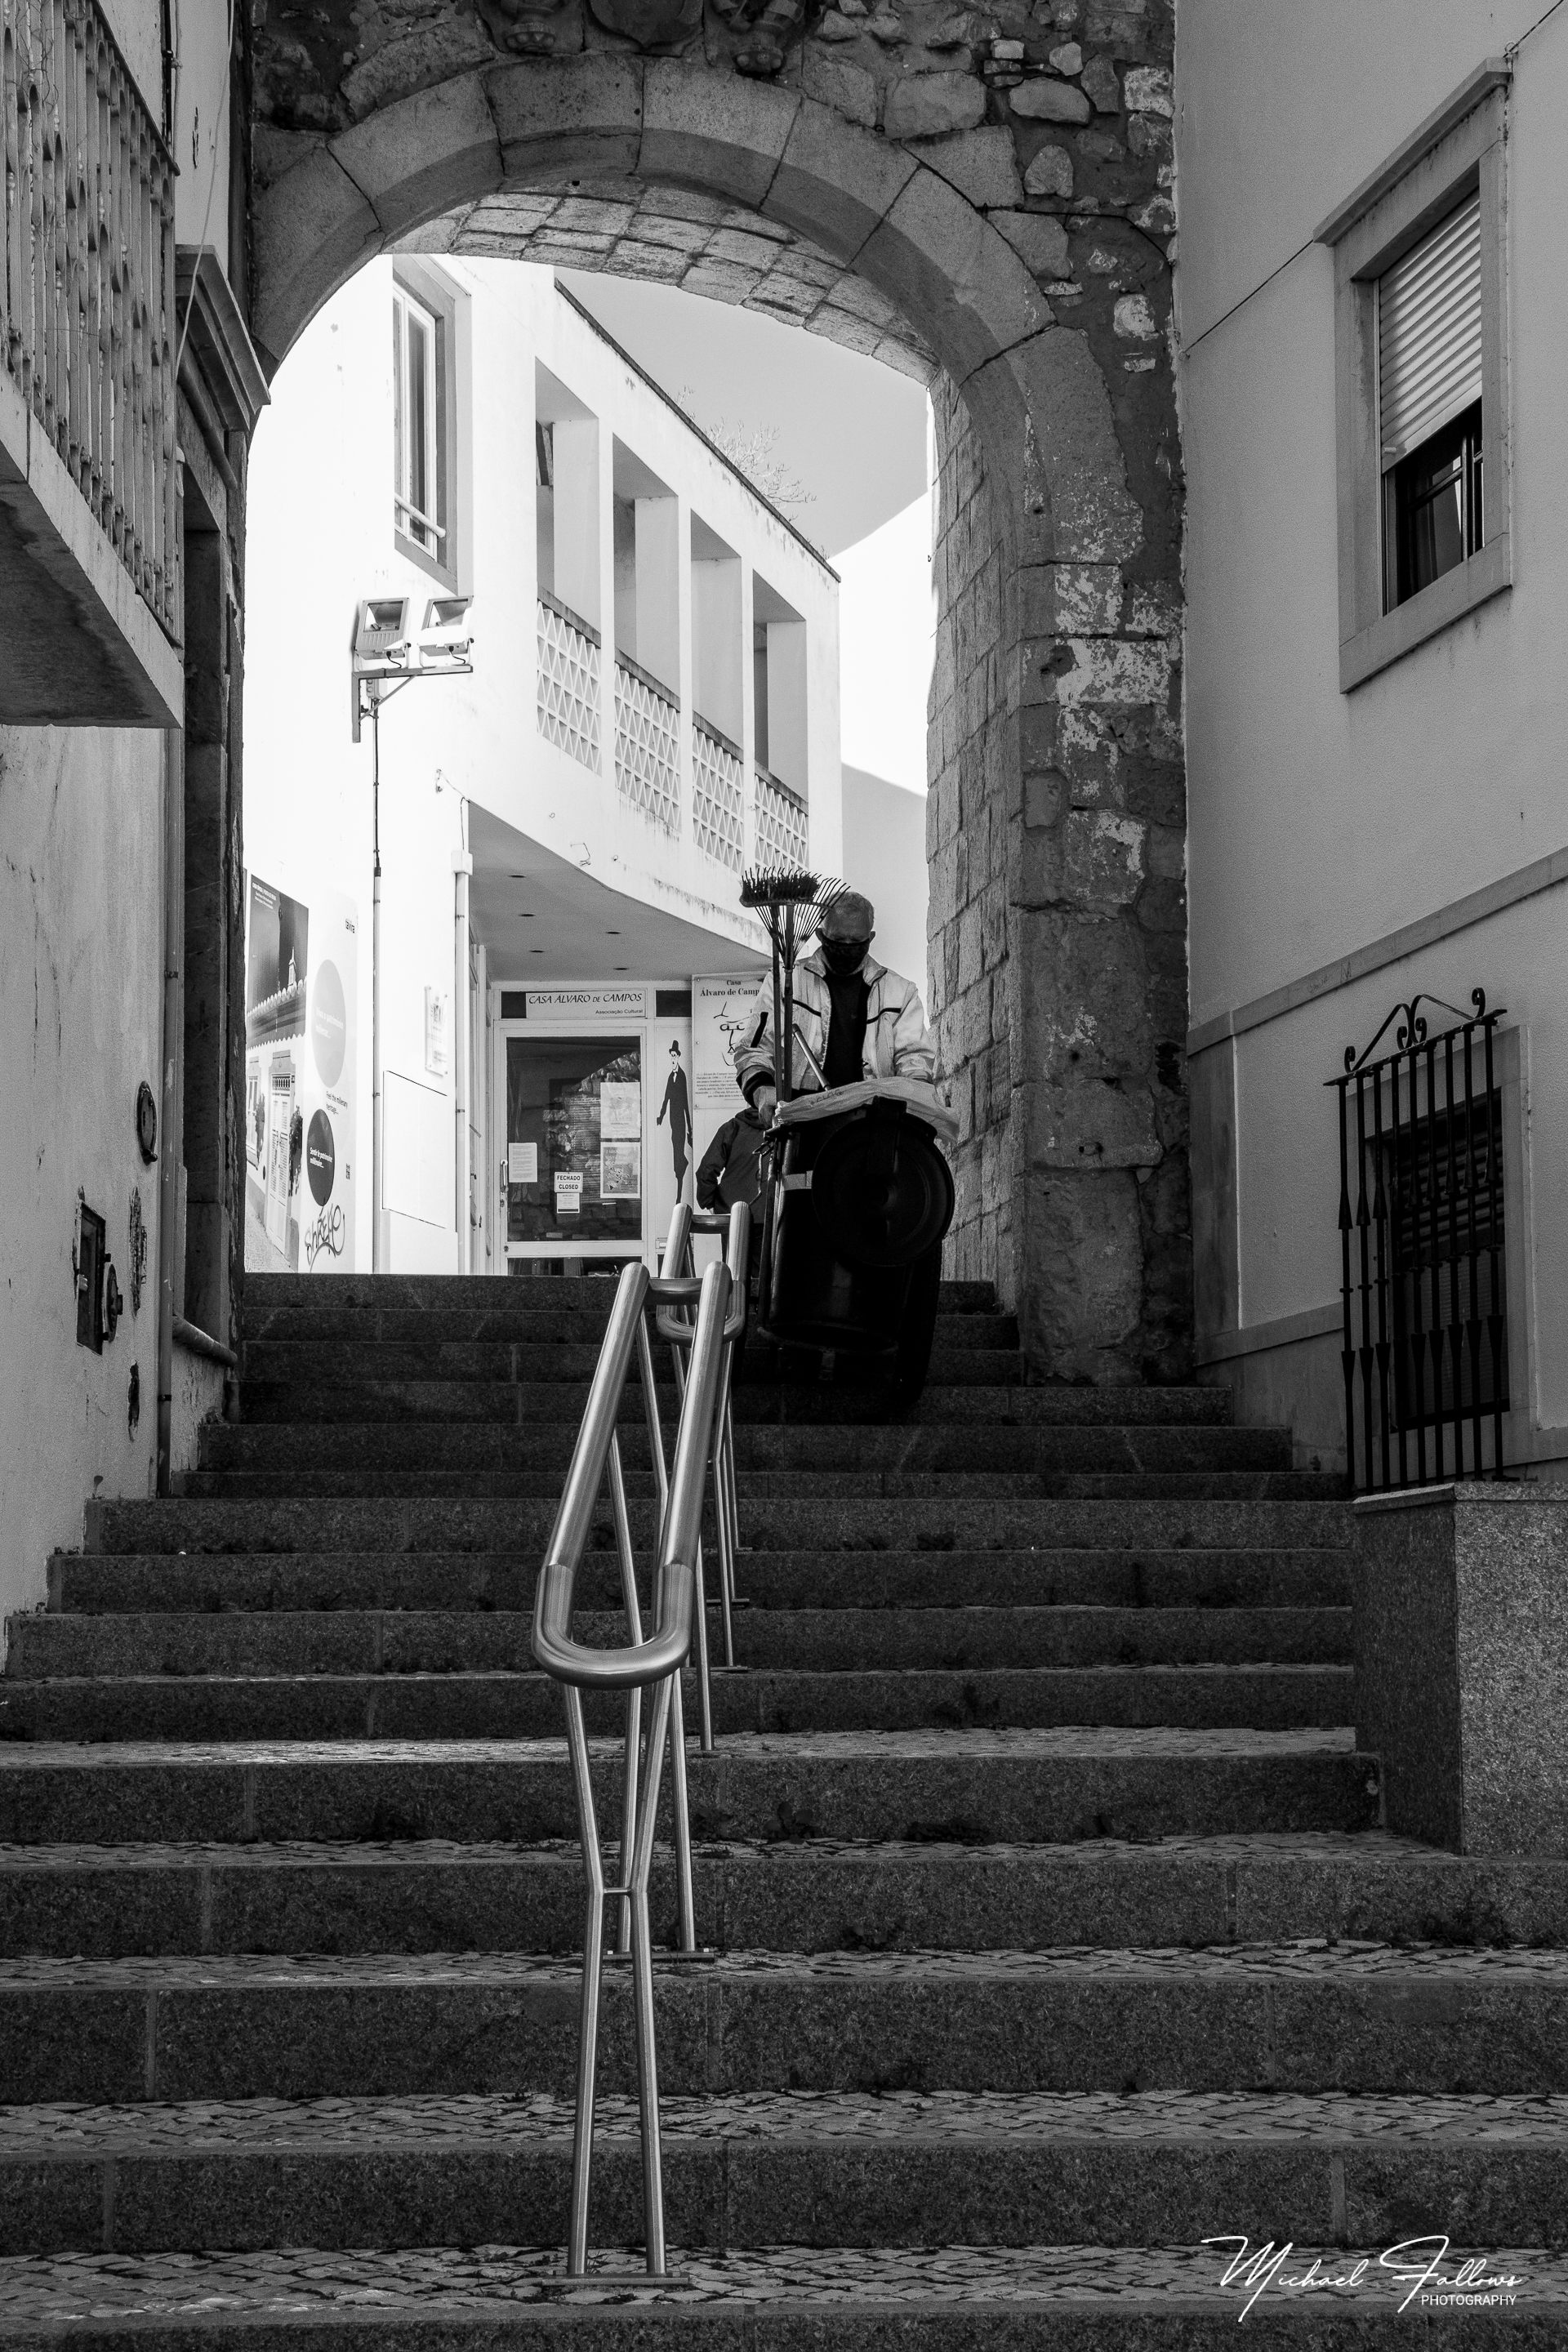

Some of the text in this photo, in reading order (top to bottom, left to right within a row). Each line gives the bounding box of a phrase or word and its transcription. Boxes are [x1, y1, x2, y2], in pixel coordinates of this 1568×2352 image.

[700, 987, 725, 996] Álvaro
[738, 987, 760, 996] Camp
[528, 996, 552, 1004] CASA
[555, 993, 590, 1004] ÁLVARO
[603, 993, 643, 1002] CAMPOS
